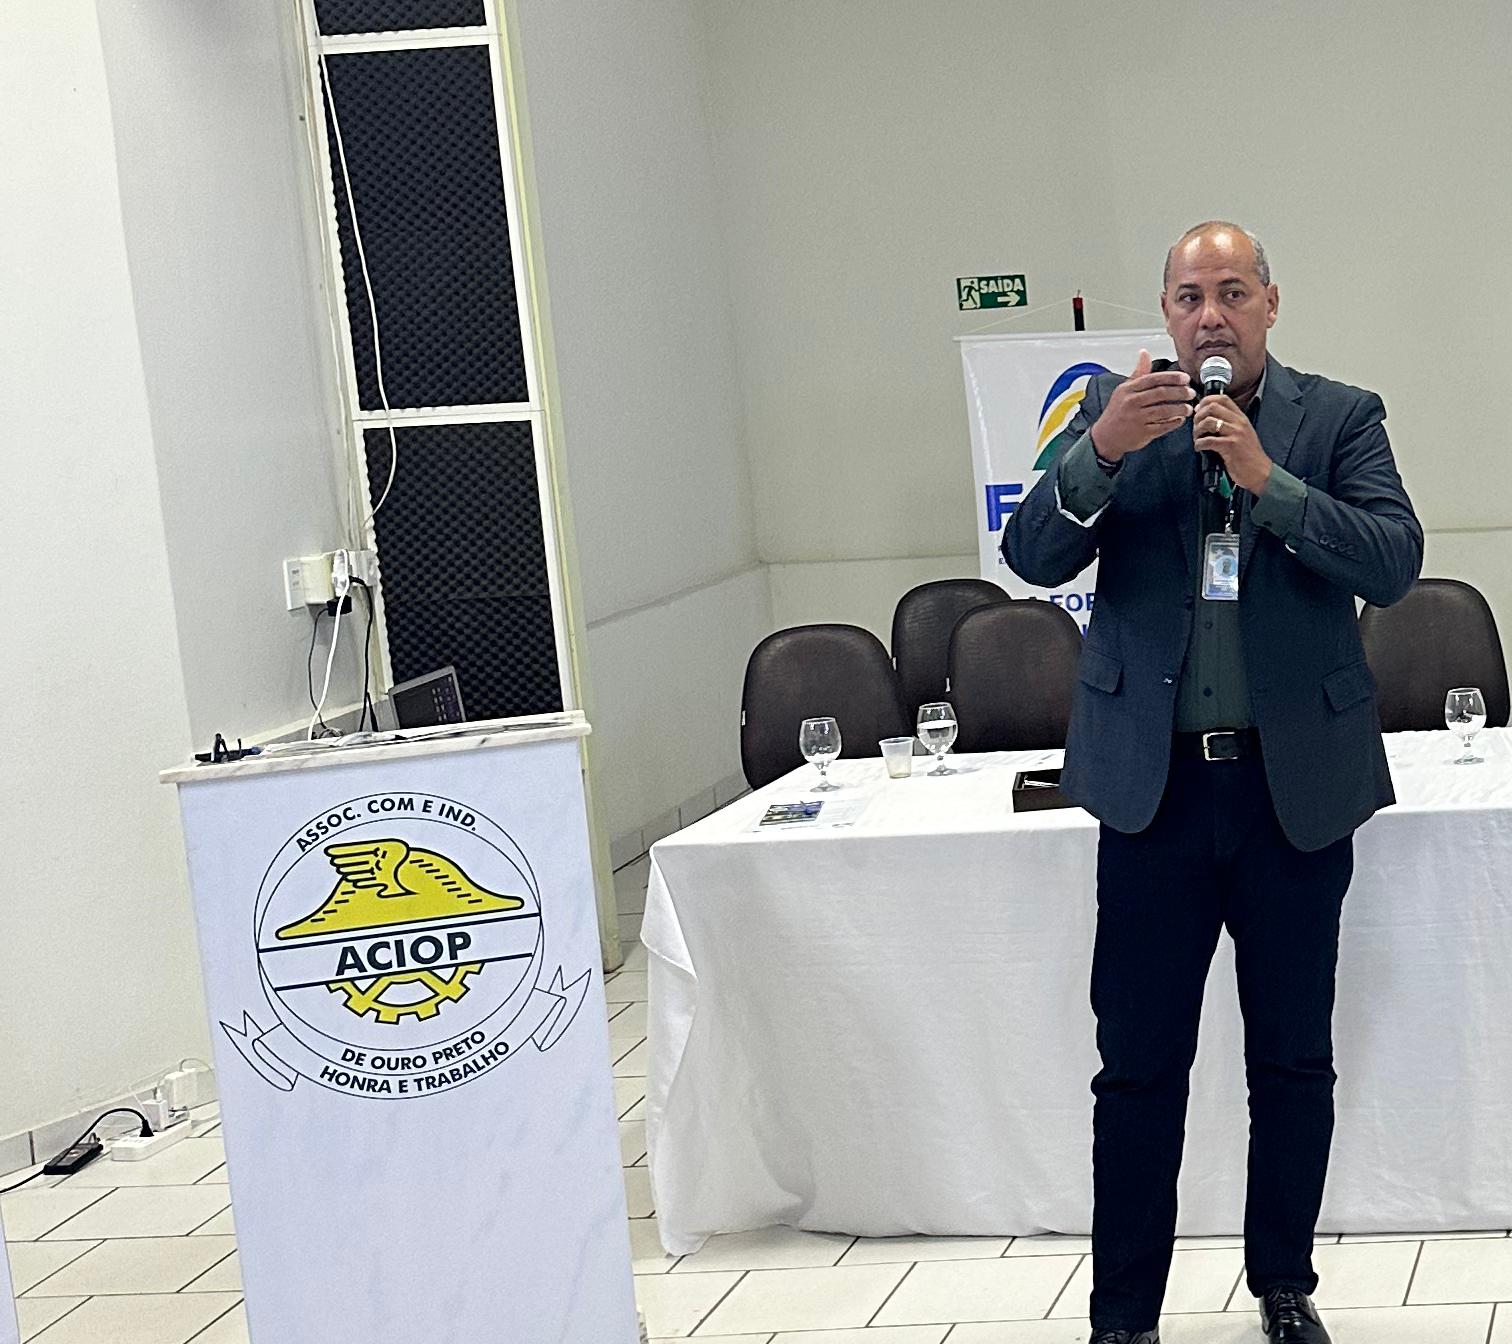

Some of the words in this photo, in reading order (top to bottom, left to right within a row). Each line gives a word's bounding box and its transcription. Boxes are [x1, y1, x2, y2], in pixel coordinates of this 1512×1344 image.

[980, 277, 1024, 293] SAÍDA
[296, 807, 361, 852] ASSOC.
[367, 797, 414, 813] COM
[422, 799, 434, 813] E
[438, 803, 476, 831] IND.
[335, 931, 472, 977] ACIOP
[319, 1065, 392, 1094] HONRA
[398, 1080, 408, 1094] E
[414, 1041, 510, 1090] TRABALHO
[341, 1048, 367, 1067] DE
[371, 1056, 427, 1071] OURO
[432, 1031, 485, 1065] PRETO
